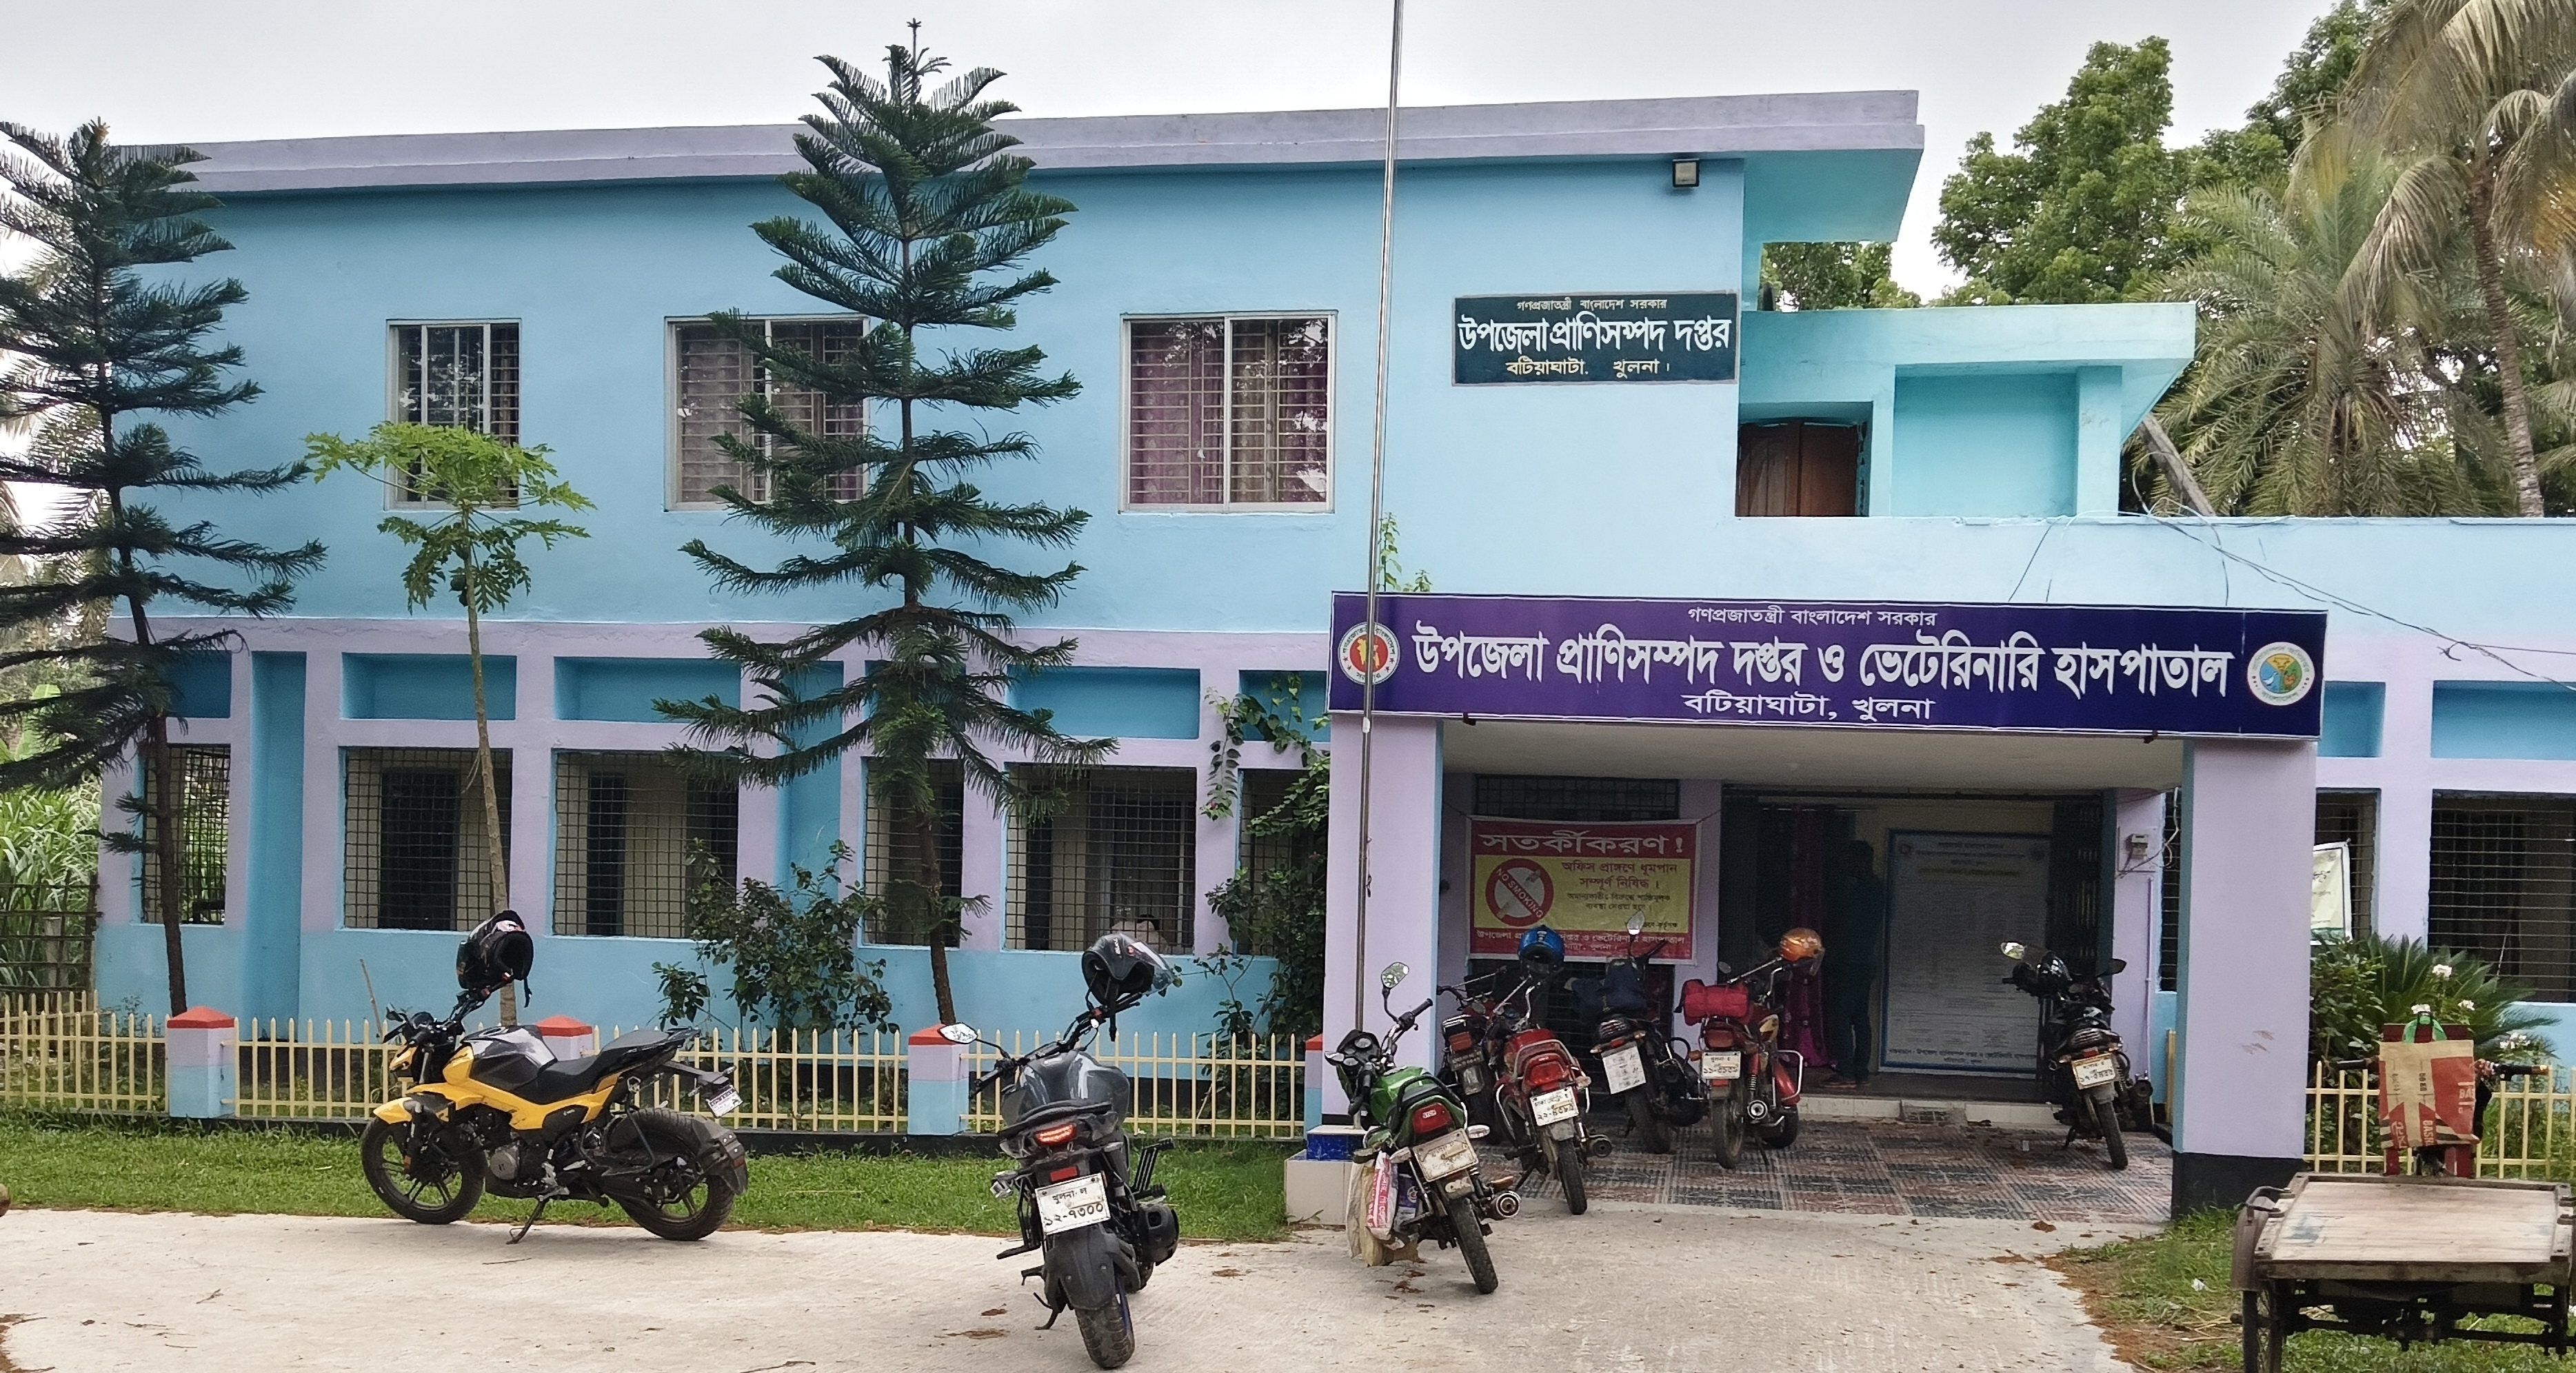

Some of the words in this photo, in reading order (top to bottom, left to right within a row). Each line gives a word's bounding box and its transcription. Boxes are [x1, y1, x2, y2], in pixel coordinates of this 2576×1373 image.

[1580, 299, 1624, 312] বাংলাদেশ
[1630, 298, 1668, 309] সরকার
[1458, 314, 1550, 355] উপজেলা
[1550, 310, 1668, 352] প্রাণিসম্পদ
[1673, 314, 1732, 352] দপ্তর
[1688, 607, 1786, 625] গণপ্রজাতন্ত্রী
[1791, 609, 1871, 626] বাংলাদেশ
[1878, 611, 1936, 627] সরকার
[1412, 620, 1549, 680] উপজেলা
[1557, 623, 1726, 684] প্রাণিসম্পদ
[1731, 635, 1808, 687] দপ্তর
[1818, 643, 1847, 682] ও
[1860, 629, 2045, 692] ভেটেরিনারি
[2053, 641, 2235, 700] হাসপাতাল
[1681, 689, 1837, 721] বটিয়াঘাটা,
[1852, 697, 1935, 721] খুলনা
[1562, 860, 1596, 872] অফিস
[1496, 868, 1509, 882] NO
[1508, 881, 1544, 918] SMOKING
[1616, 876, 1649, 889] নিষিদ্ধ
